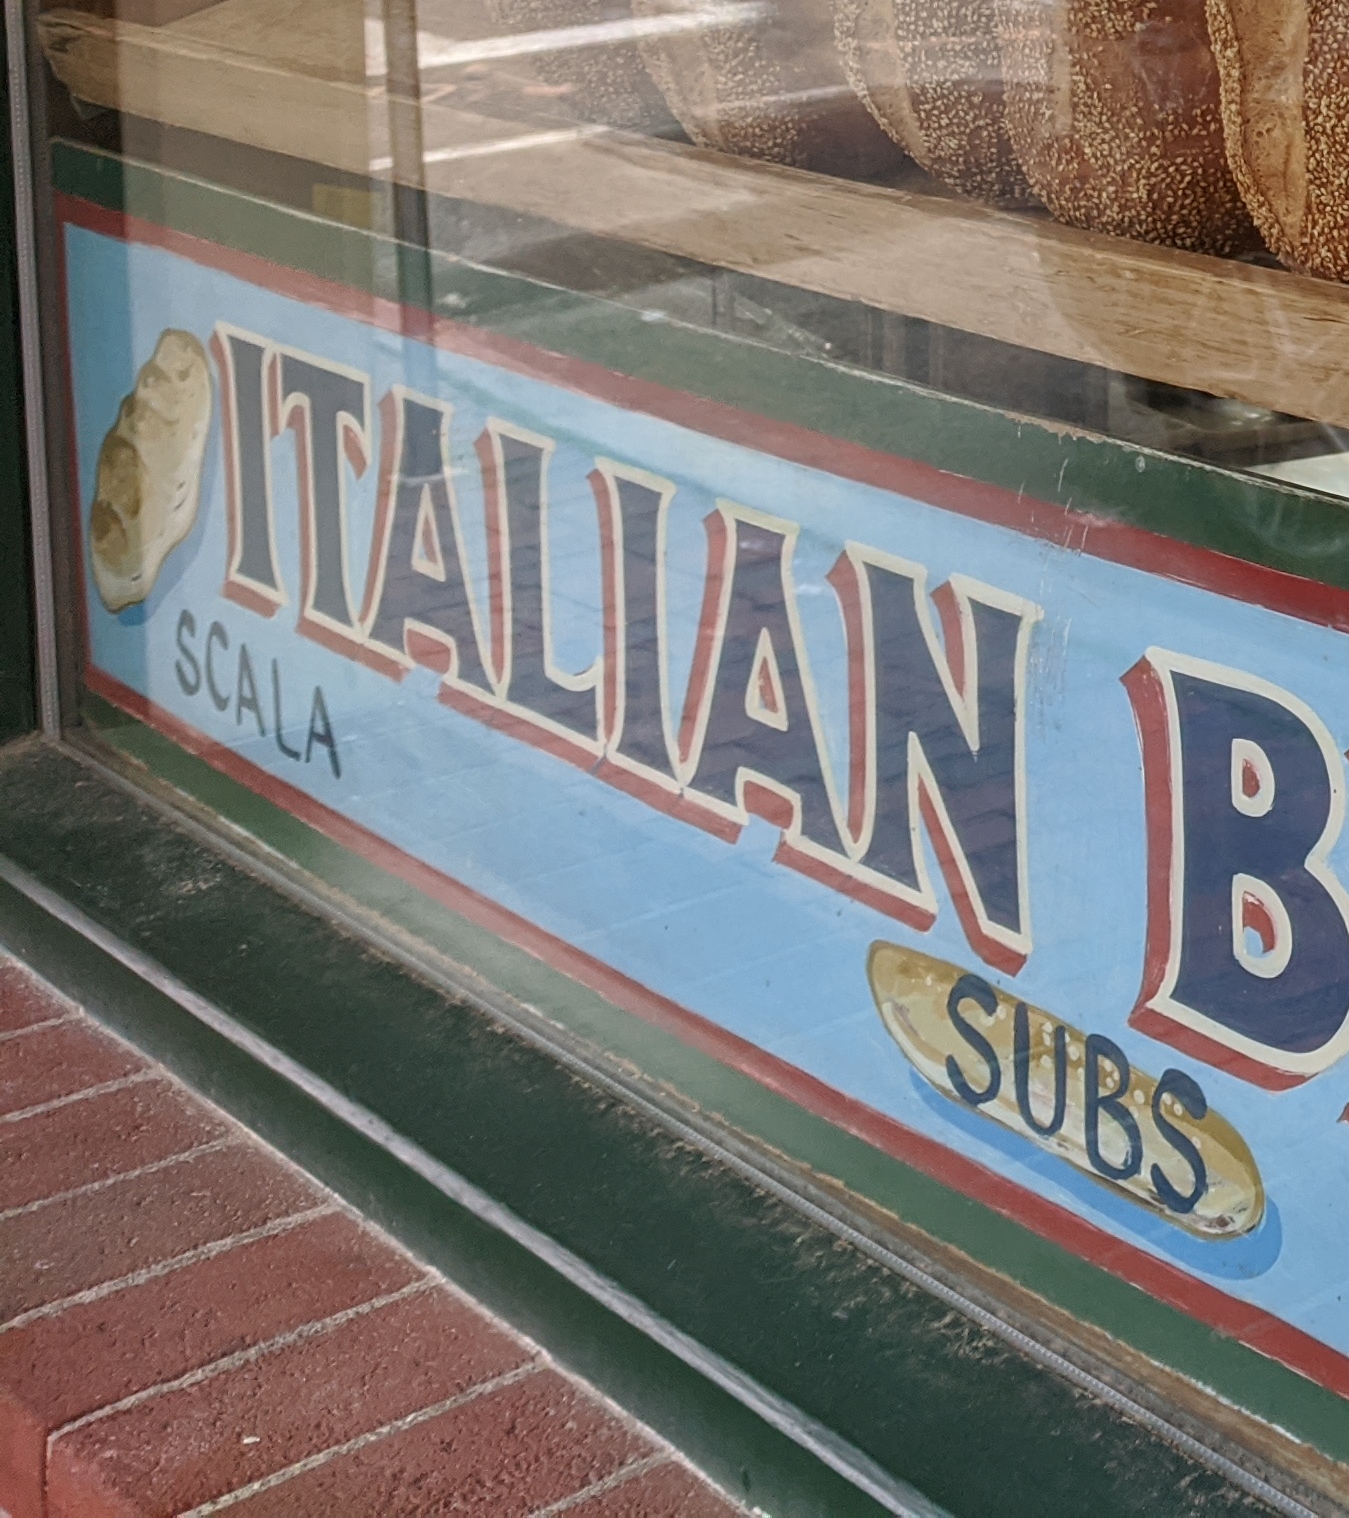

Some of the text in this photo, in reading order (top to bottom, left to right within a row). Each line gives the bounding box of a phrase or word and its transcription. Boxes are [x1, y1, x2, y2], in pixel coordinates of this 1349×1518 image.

[175, 608, 342, 780] SCALA
[209, 321, 1043, 978] ITALIAN
[945, 973, 1208, 1213] SUBS
